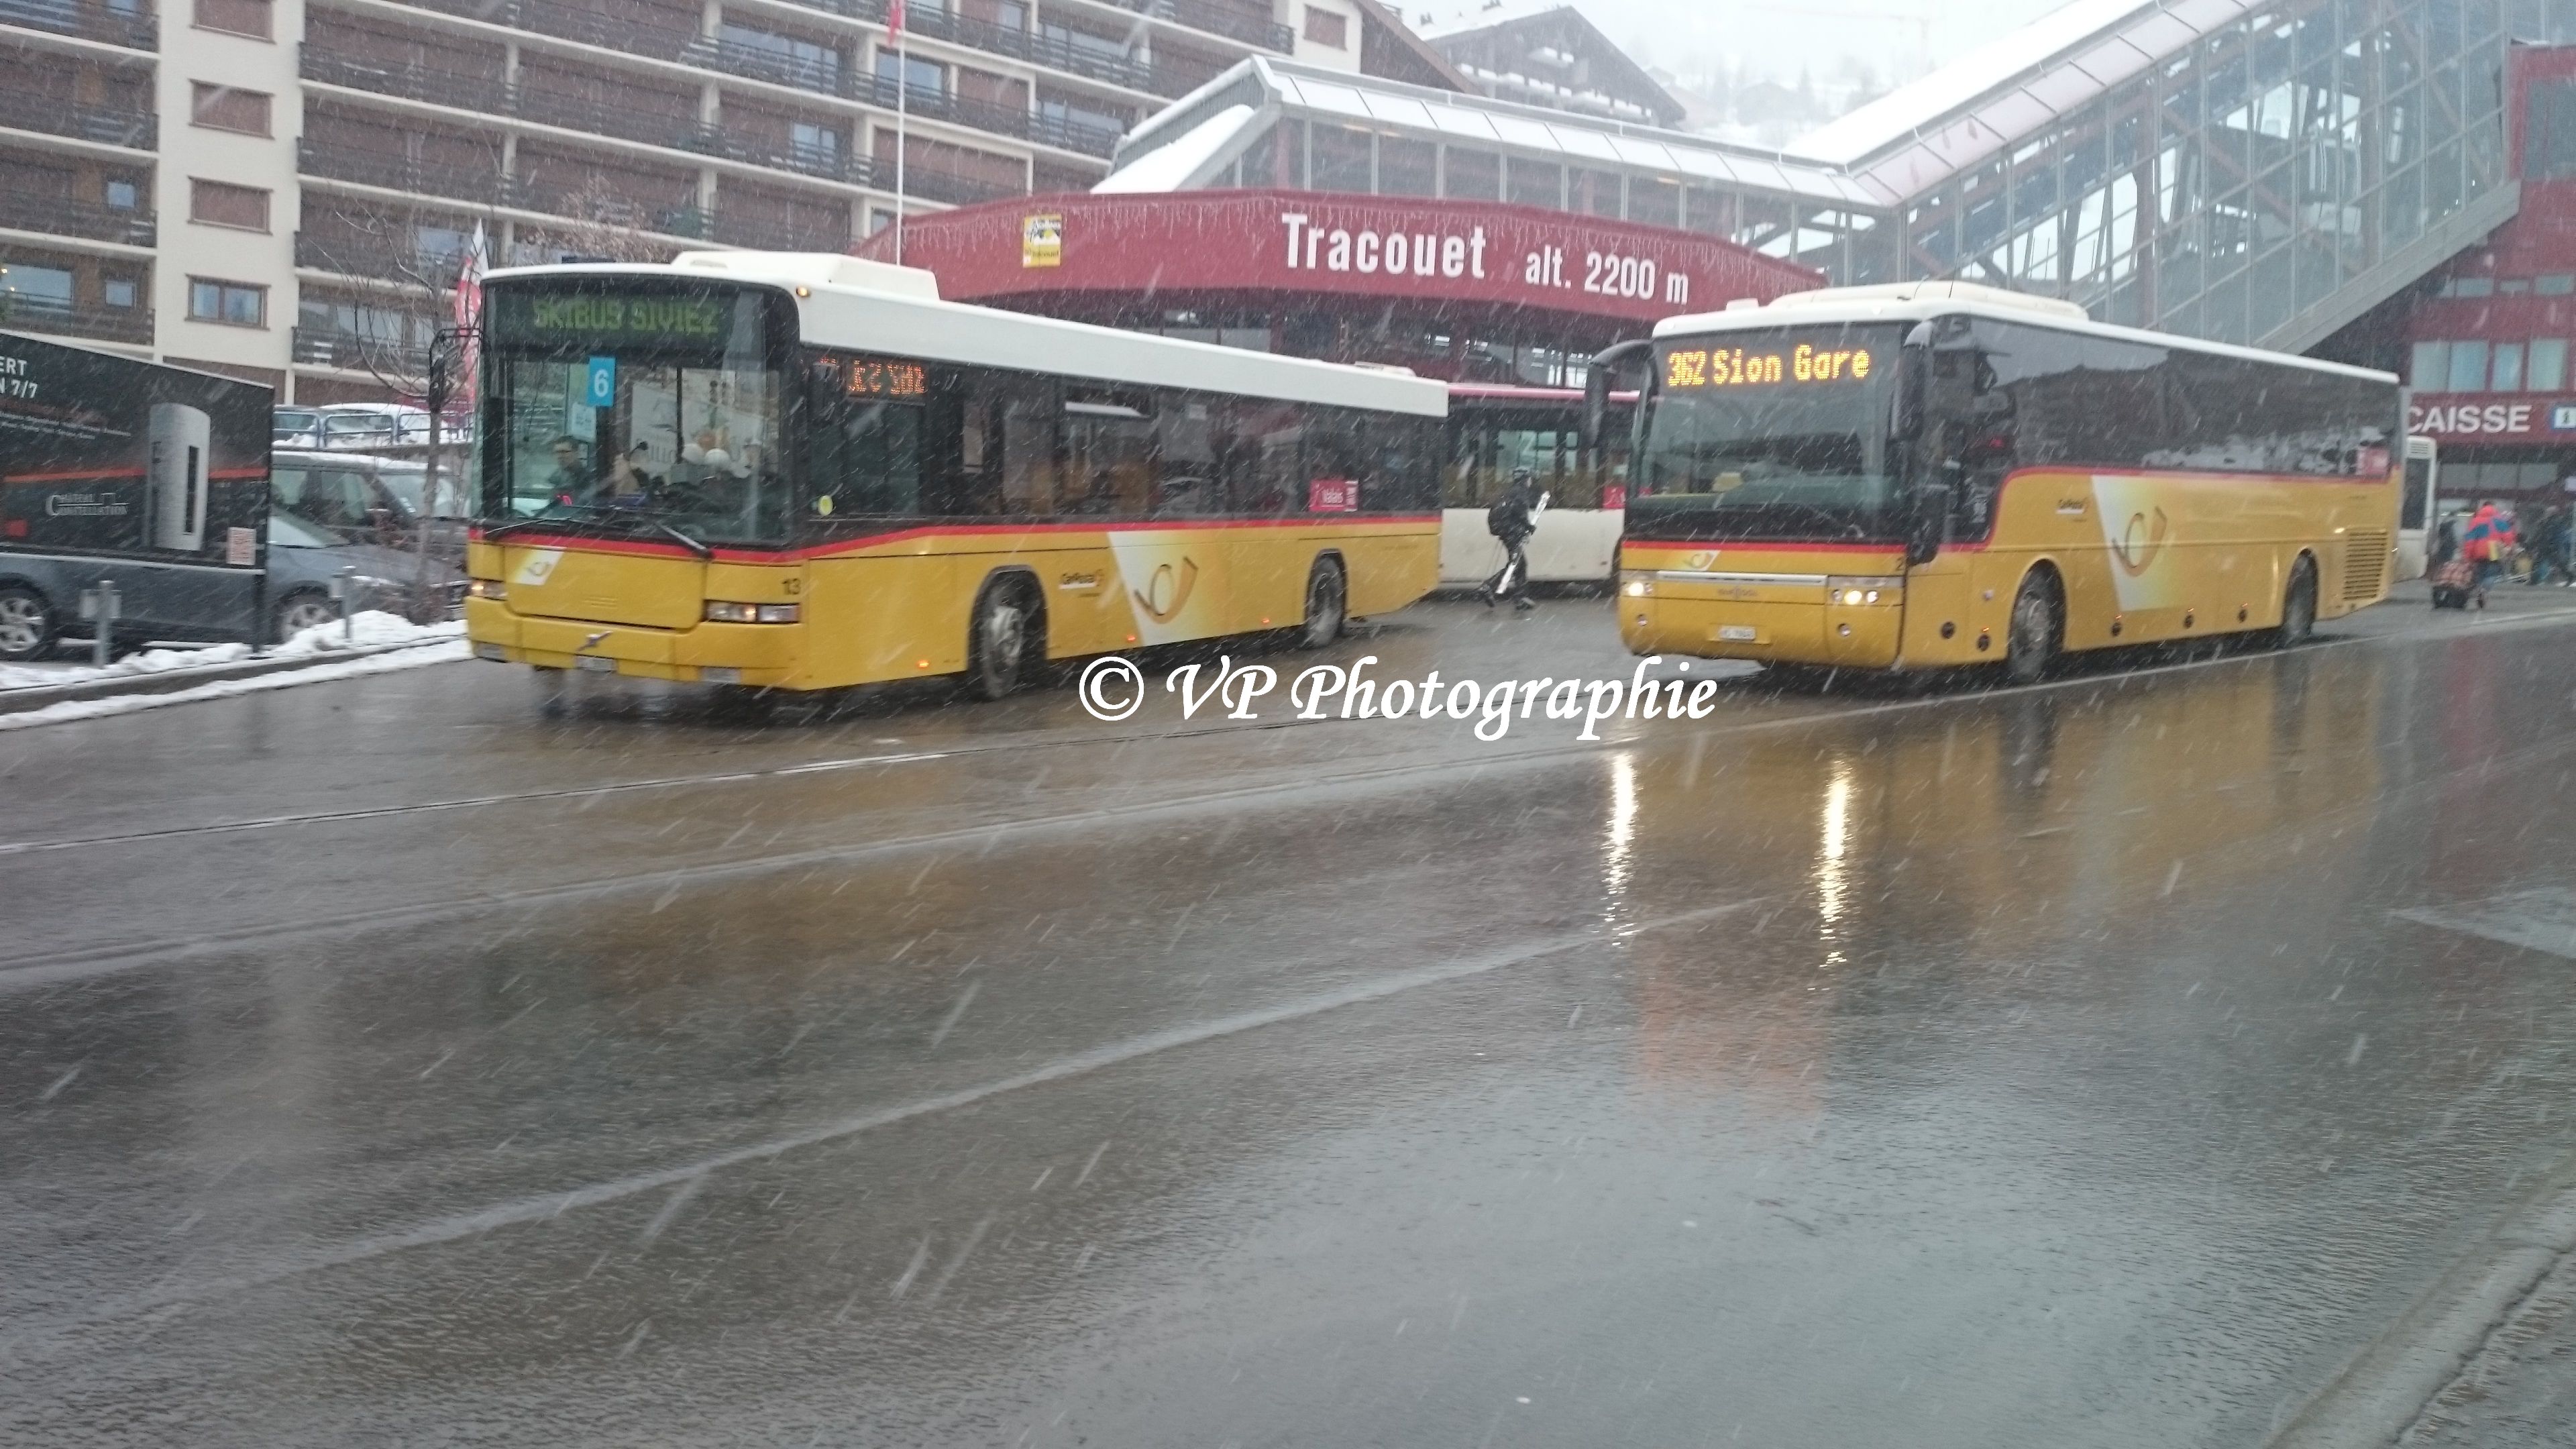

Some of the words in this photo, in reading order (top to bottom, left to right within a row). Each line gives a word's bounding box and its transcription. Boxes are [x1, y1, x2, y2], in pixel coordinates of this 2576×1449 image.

[1282, 212, 1487, 279] Tracouet
[1525, 244, 1572, 289] alt.
[1583, 250, 1656, 300] 2200
[1666, 272, 1689, 305] m
[533, 300, 624, 329] SKIBUS
[1668, 350, 1707, 387] 362
[1713, 348, 1782, 385] Sion
[1794, 343, 1870, 382] Gare
[11, 379, 38, 399] 7/7
[594, 369, 609, 397] 6
[2407, 405, 2532, 434] CAISSE
[782, 578, 801, 595] 13
